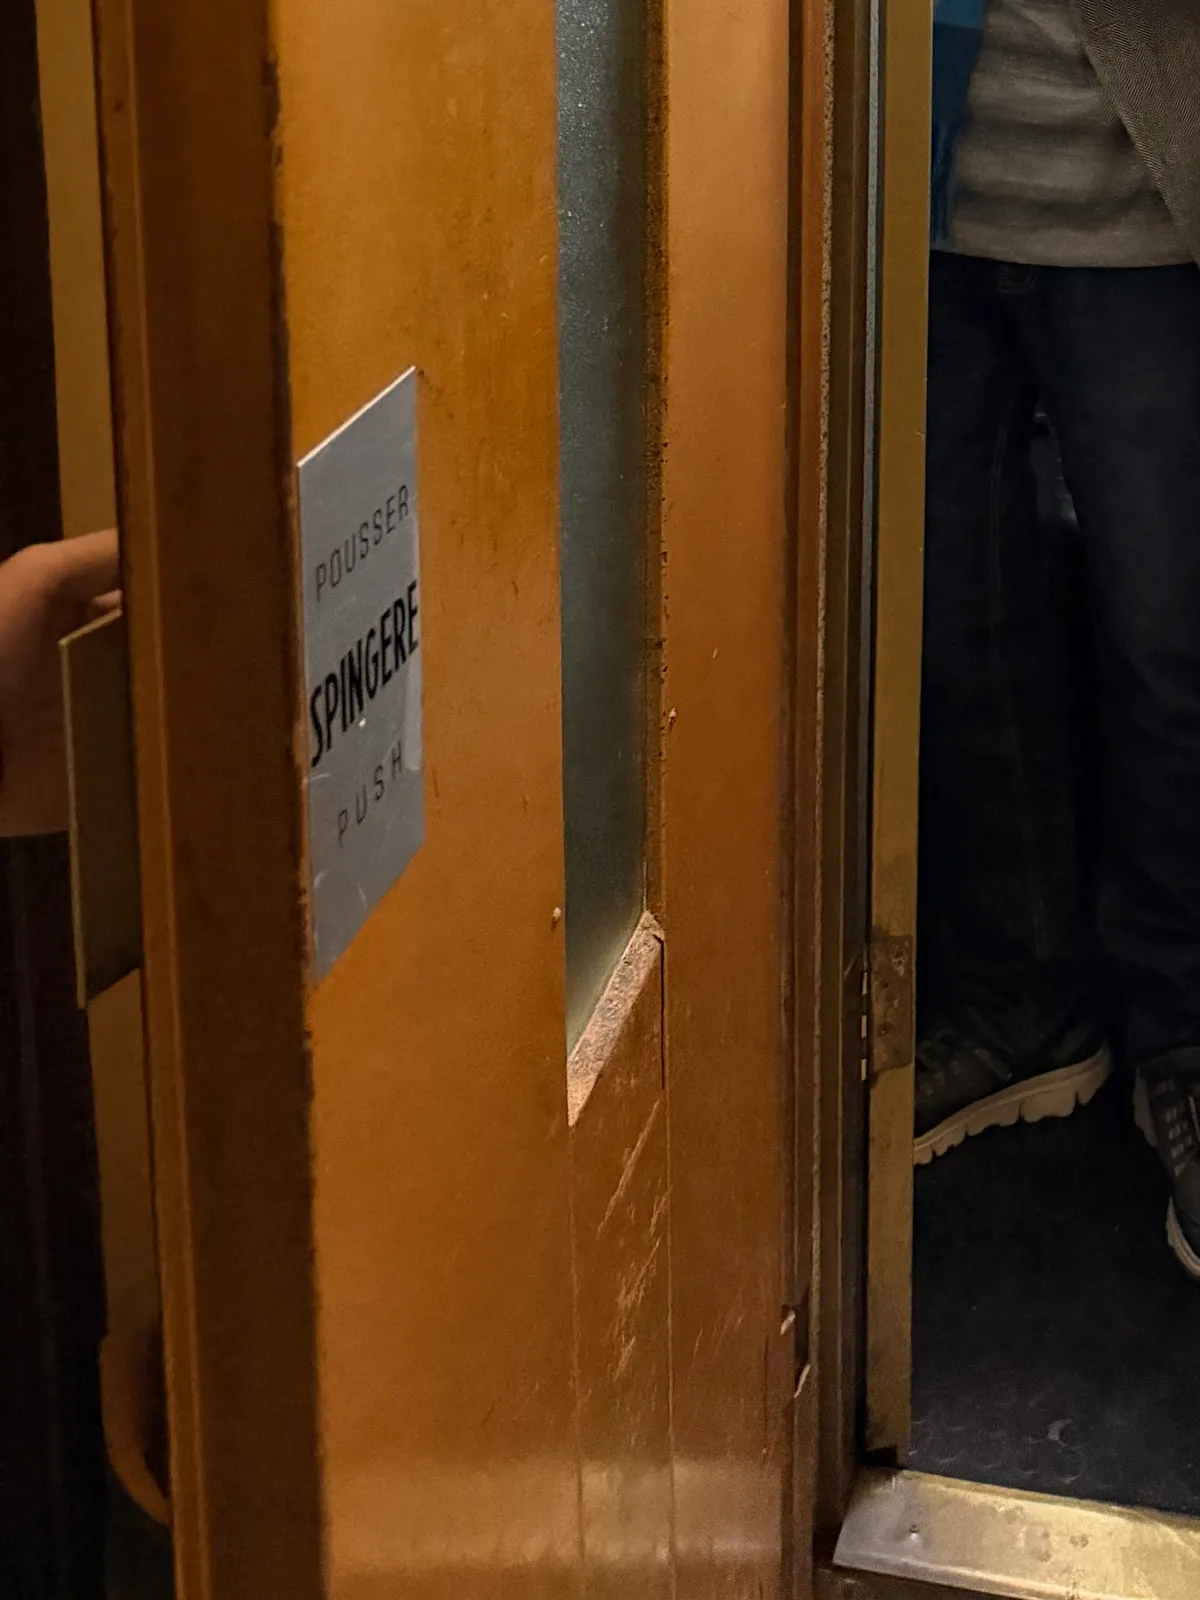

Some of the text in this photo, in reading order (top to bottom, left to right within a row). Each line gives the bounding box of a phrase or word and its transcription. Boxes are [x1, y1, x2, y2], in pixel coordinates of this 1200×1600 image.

[315, 485, 409, 604] POUSSER
[311, 579, 418, 768] SPINGERE
[338, 740, 402, 848] PUSH
